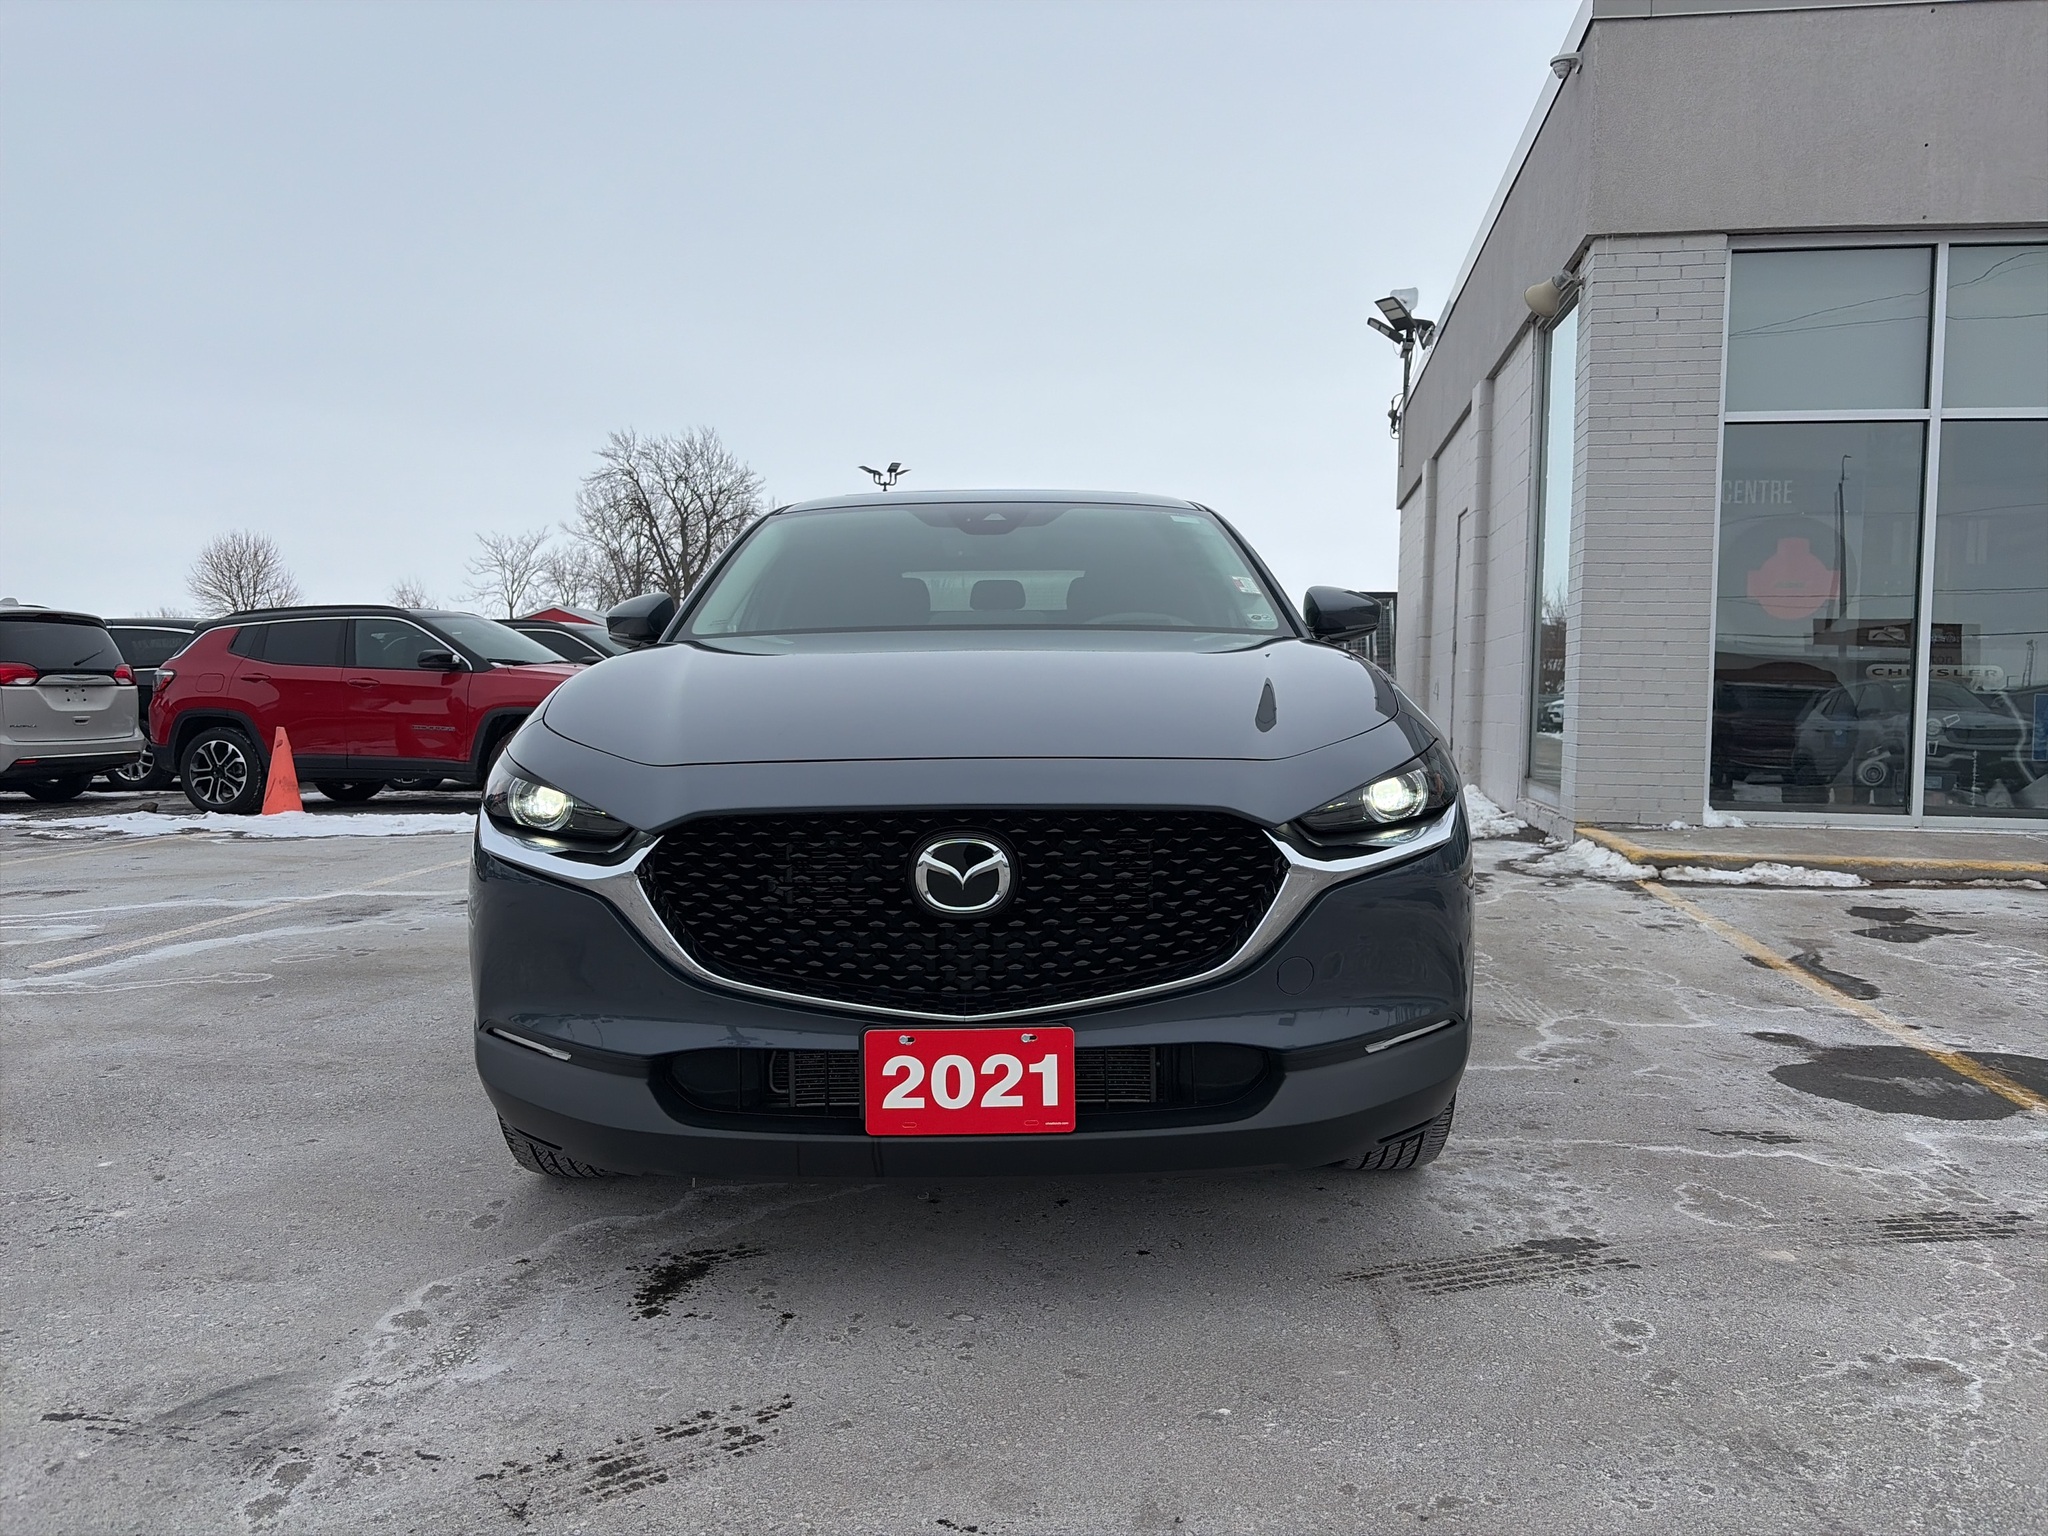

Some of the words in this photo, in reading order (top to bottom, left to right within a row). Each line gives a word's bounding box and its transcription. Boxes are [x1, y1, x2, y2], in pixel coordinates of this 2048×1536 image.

[1721, 480, 1793, 504] CENTRE
[1871, 667, 1998, 678] CHSLER
[881, 1053, 1059, 1110] 2021
